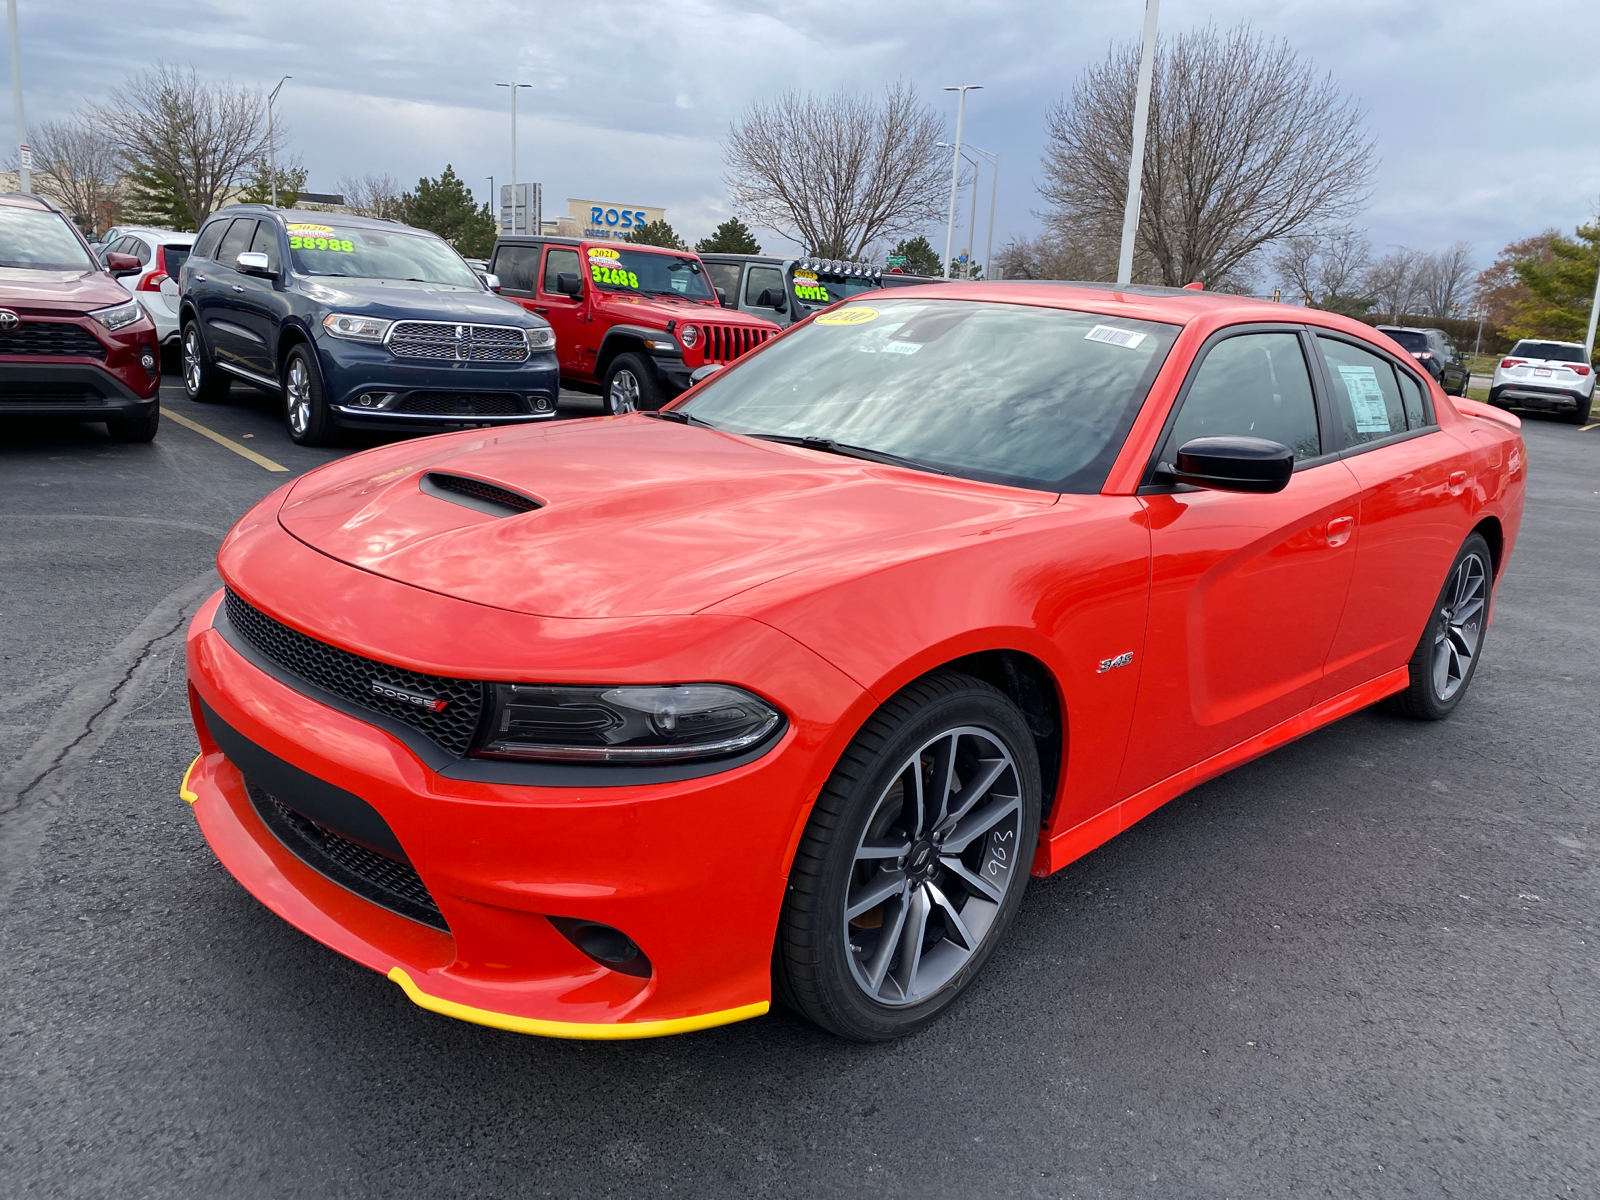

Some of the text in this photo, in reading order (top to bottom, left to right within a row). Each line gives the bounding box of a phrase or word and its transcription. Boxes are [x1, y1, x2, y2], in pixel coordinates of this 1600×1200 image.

[591, 207, 646, 228] ROSS
[585, 229, 610, 238] DRESS
[290, 237, 353, 252] 38988
[595, 250, 613, 258] 2021
[591, 266, 638, 288] 32688
[798, 271, 814, 279] 2023
[1096, 651, 1134, 674] 345
[372, 685, 436, 708] DODGE
[987, 830, 1013, 876] 963
